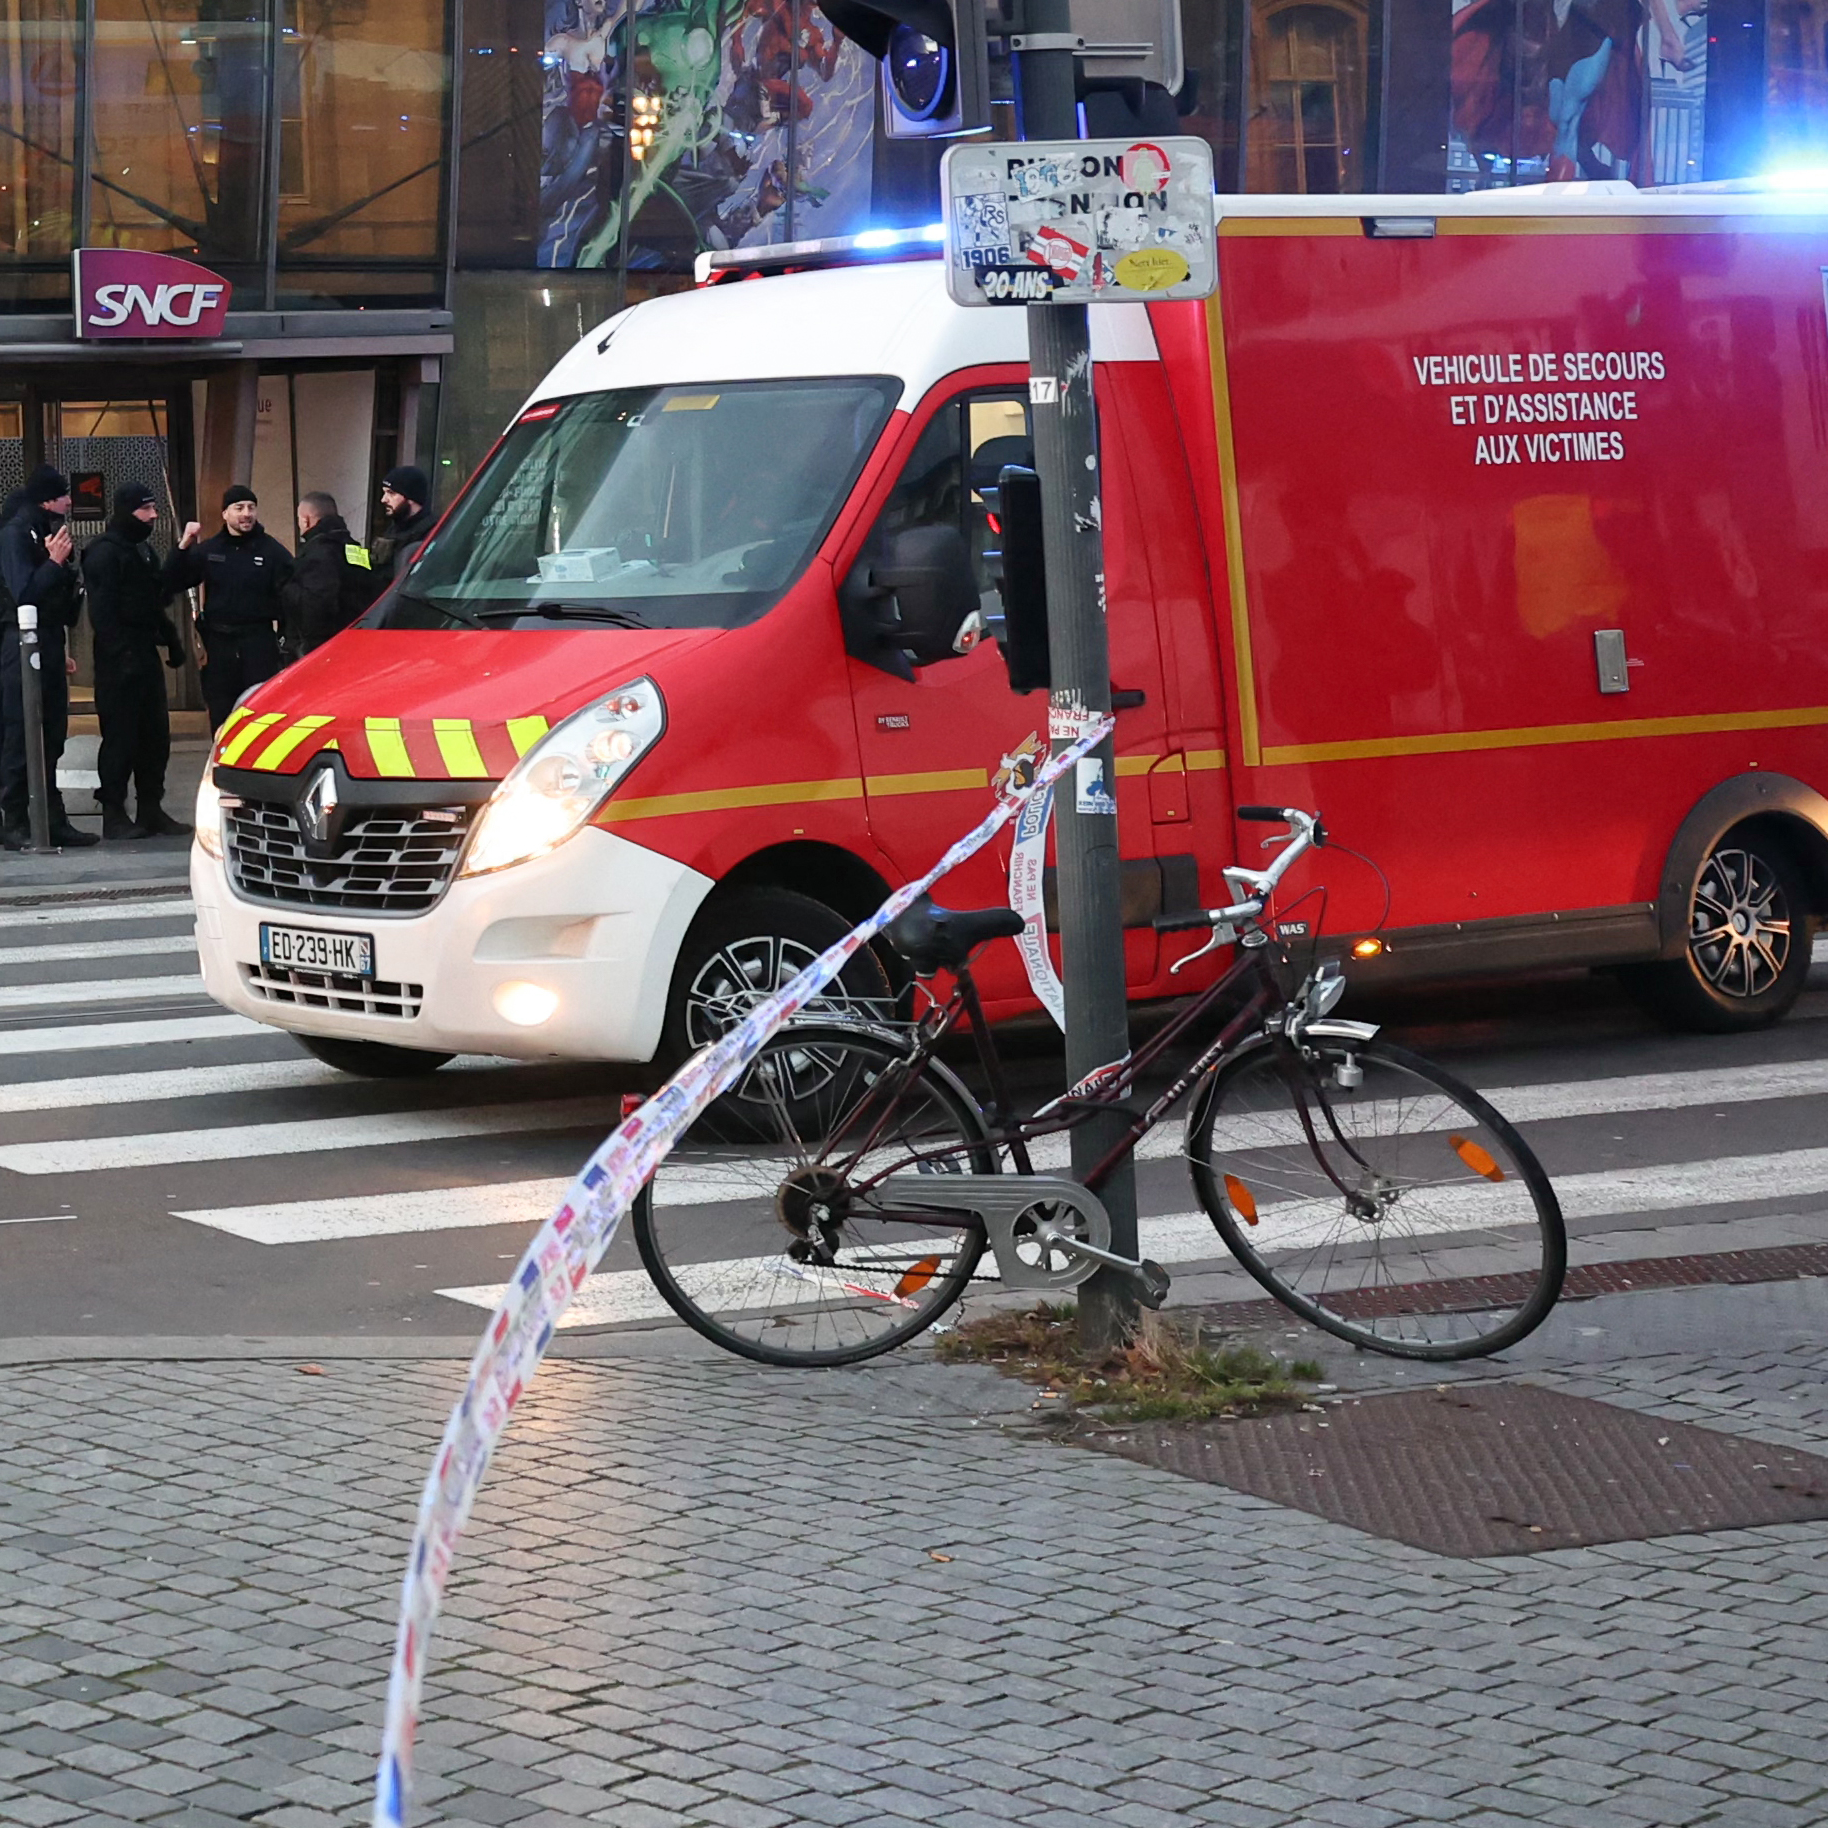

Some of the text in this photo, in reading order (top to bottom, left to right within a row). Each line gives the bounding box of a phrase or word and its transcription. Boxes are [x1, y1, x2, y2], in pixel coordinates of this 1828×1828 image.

[962, 247, 1011, 268] 1906
[984, 271, 1049, 299] 20 ANS
[89, 284, 223, 327] SNCF
[1414, 352, 1664, 385] VEHICULE DE SECOURS
[1033, 381, 1052, 400] 17
[1451, 392, 1637, 425] ET D'ASSISTANCE
[1476, 432, 1624, 464] AUX VICTIMES
[1063, 726, 1080, 737] NE
[1279, 923, 1305, 936] WAS
[360, 957, 371, 971] 67
